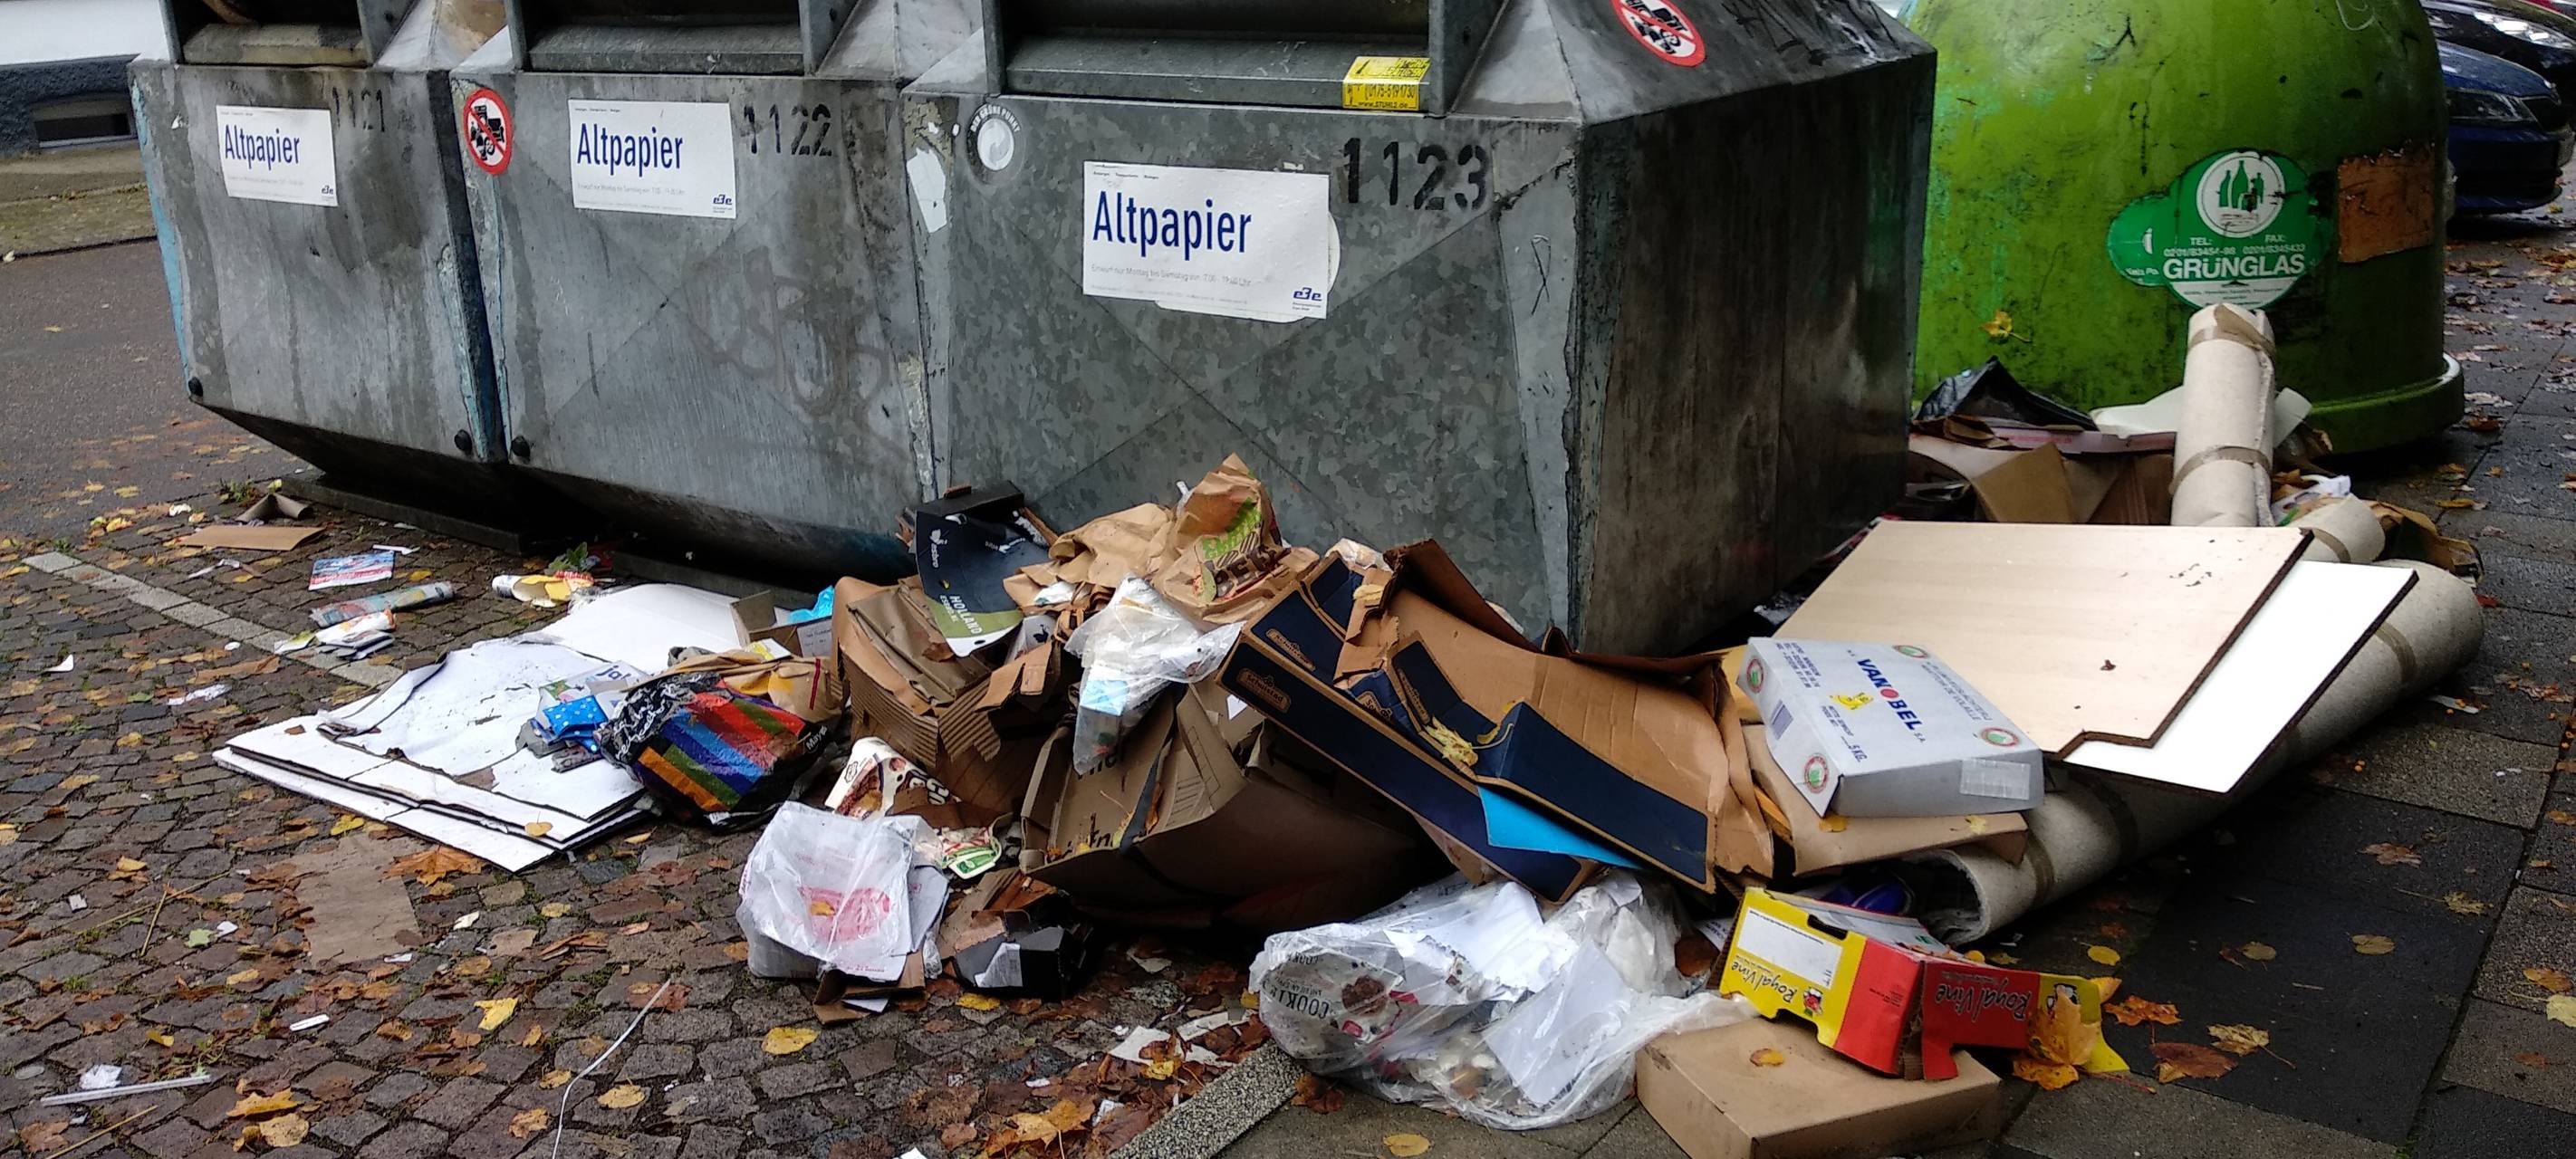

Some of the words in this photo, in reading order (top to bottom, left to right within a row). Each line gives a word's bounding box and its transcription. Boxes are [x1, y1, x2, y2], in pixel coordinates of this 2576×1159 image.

[225, 124, 300, 171] Altpapier
[577, 122, 683, 177] Altpapier
[744, 103, 832, 157] 1122
[1343, 138, 1490, 210] 1123
[1092, 191, 1252, 261] Altpapier
[2163, 254, 2306, 279] GRÜNGLAS
[949, 595, 983, 635] HOLLAND
[1731, 961, 1755, 984] Vine
[1754, 971, 1798, 1004] Royal
[1936, 983, 1975, 1016] Vine
[1972, 977, 2033, 1021] Royal
